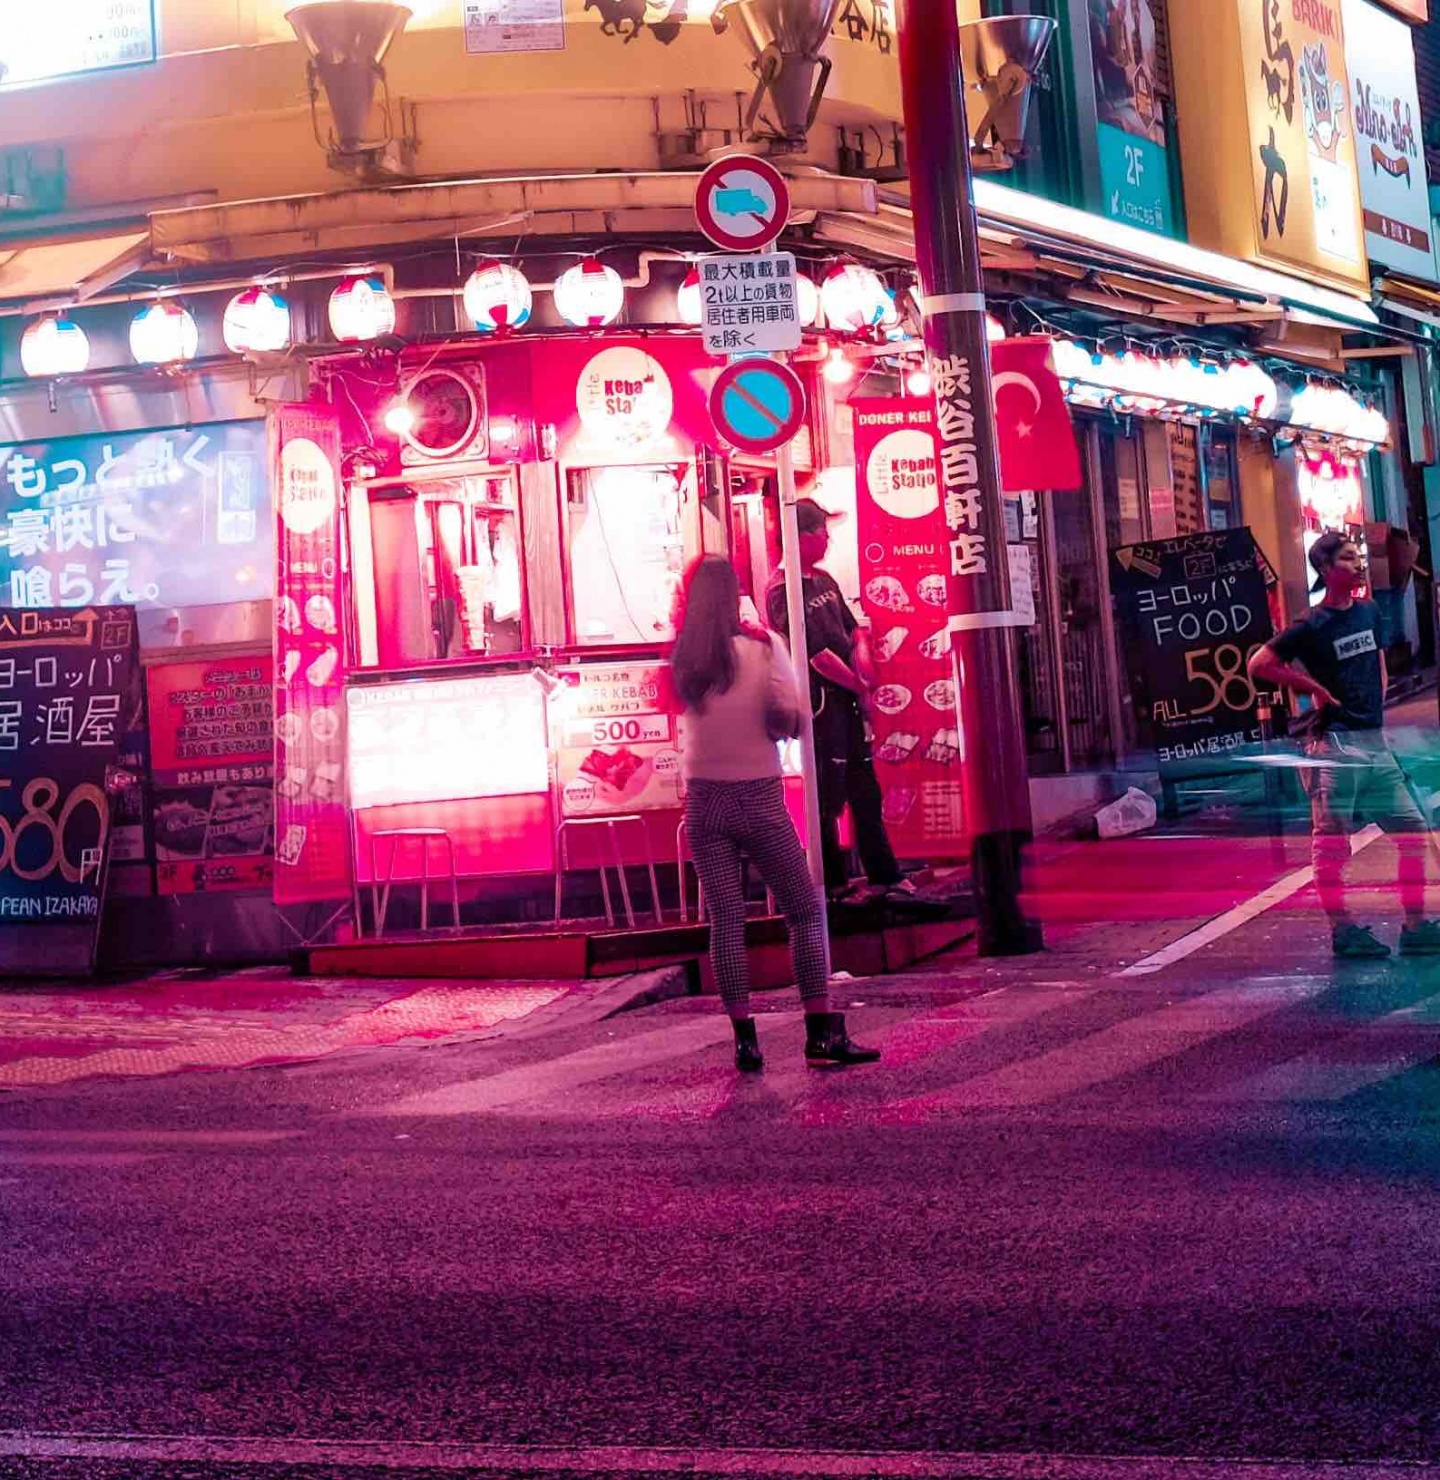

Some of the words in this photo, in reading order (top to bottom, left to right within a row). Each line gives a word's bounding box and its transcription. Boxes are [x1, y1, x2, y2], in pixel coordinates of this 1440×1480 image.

[1124, 143, 1144, 189] 2F
[704, 260, 791, 281] 最大積載量
[707, 304, 795, 326] 居住者用車両
[709, 329, 756, 348] を除く
[932, 353, 988, 576] 渋谷百軒店
[7, 503, 136, 558] 豪快に
[892, 544, 935, 556] MENU
[1137, 576, 1236, 612] ヨーロッパ
[1153, 604, 1252, 645] FOOD
[0, 653, 122, 688] ヨーロッパ
[1153, 698, 1187, 721] ALL
[1184, 642, 1263, 715] 58
[594, 720, 641, 741] 500
[44, 894, 98, 916] IZAKAYA
